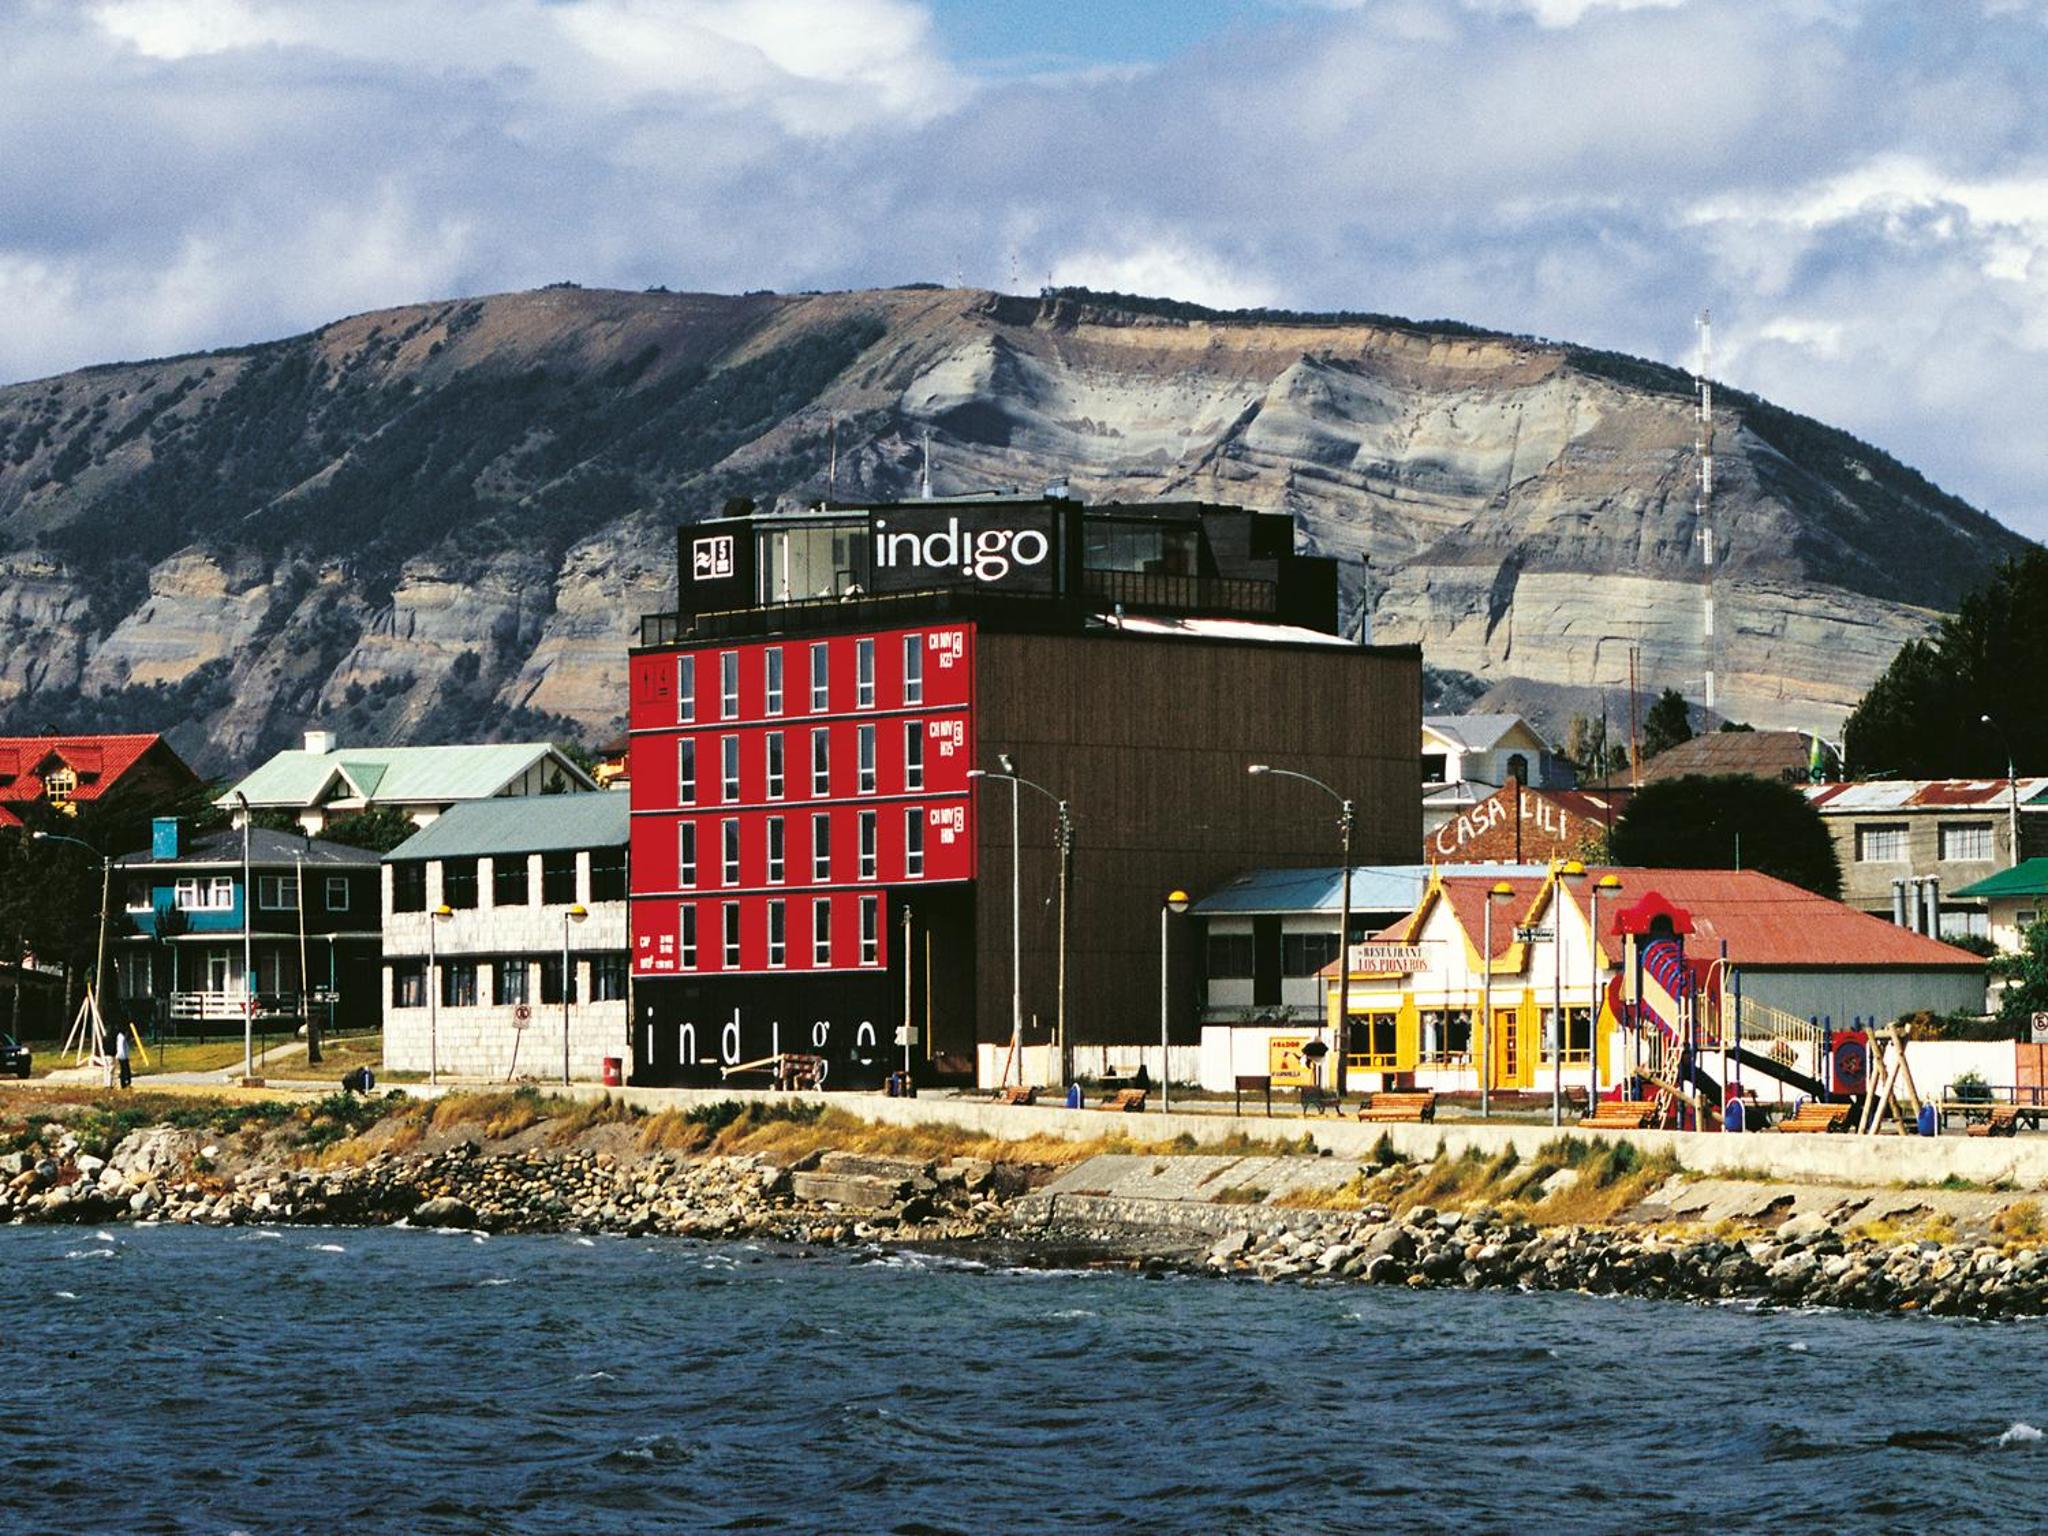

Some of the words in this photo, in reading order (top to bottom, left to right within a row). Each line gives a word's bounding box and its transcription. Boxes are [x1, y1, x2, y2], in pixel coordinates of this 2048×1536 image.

[1435, 797, 1506, 855] CASA
[1358, 959, 1377, 970] LOS
[1380, 959, 1428, 971] PIONEROS
